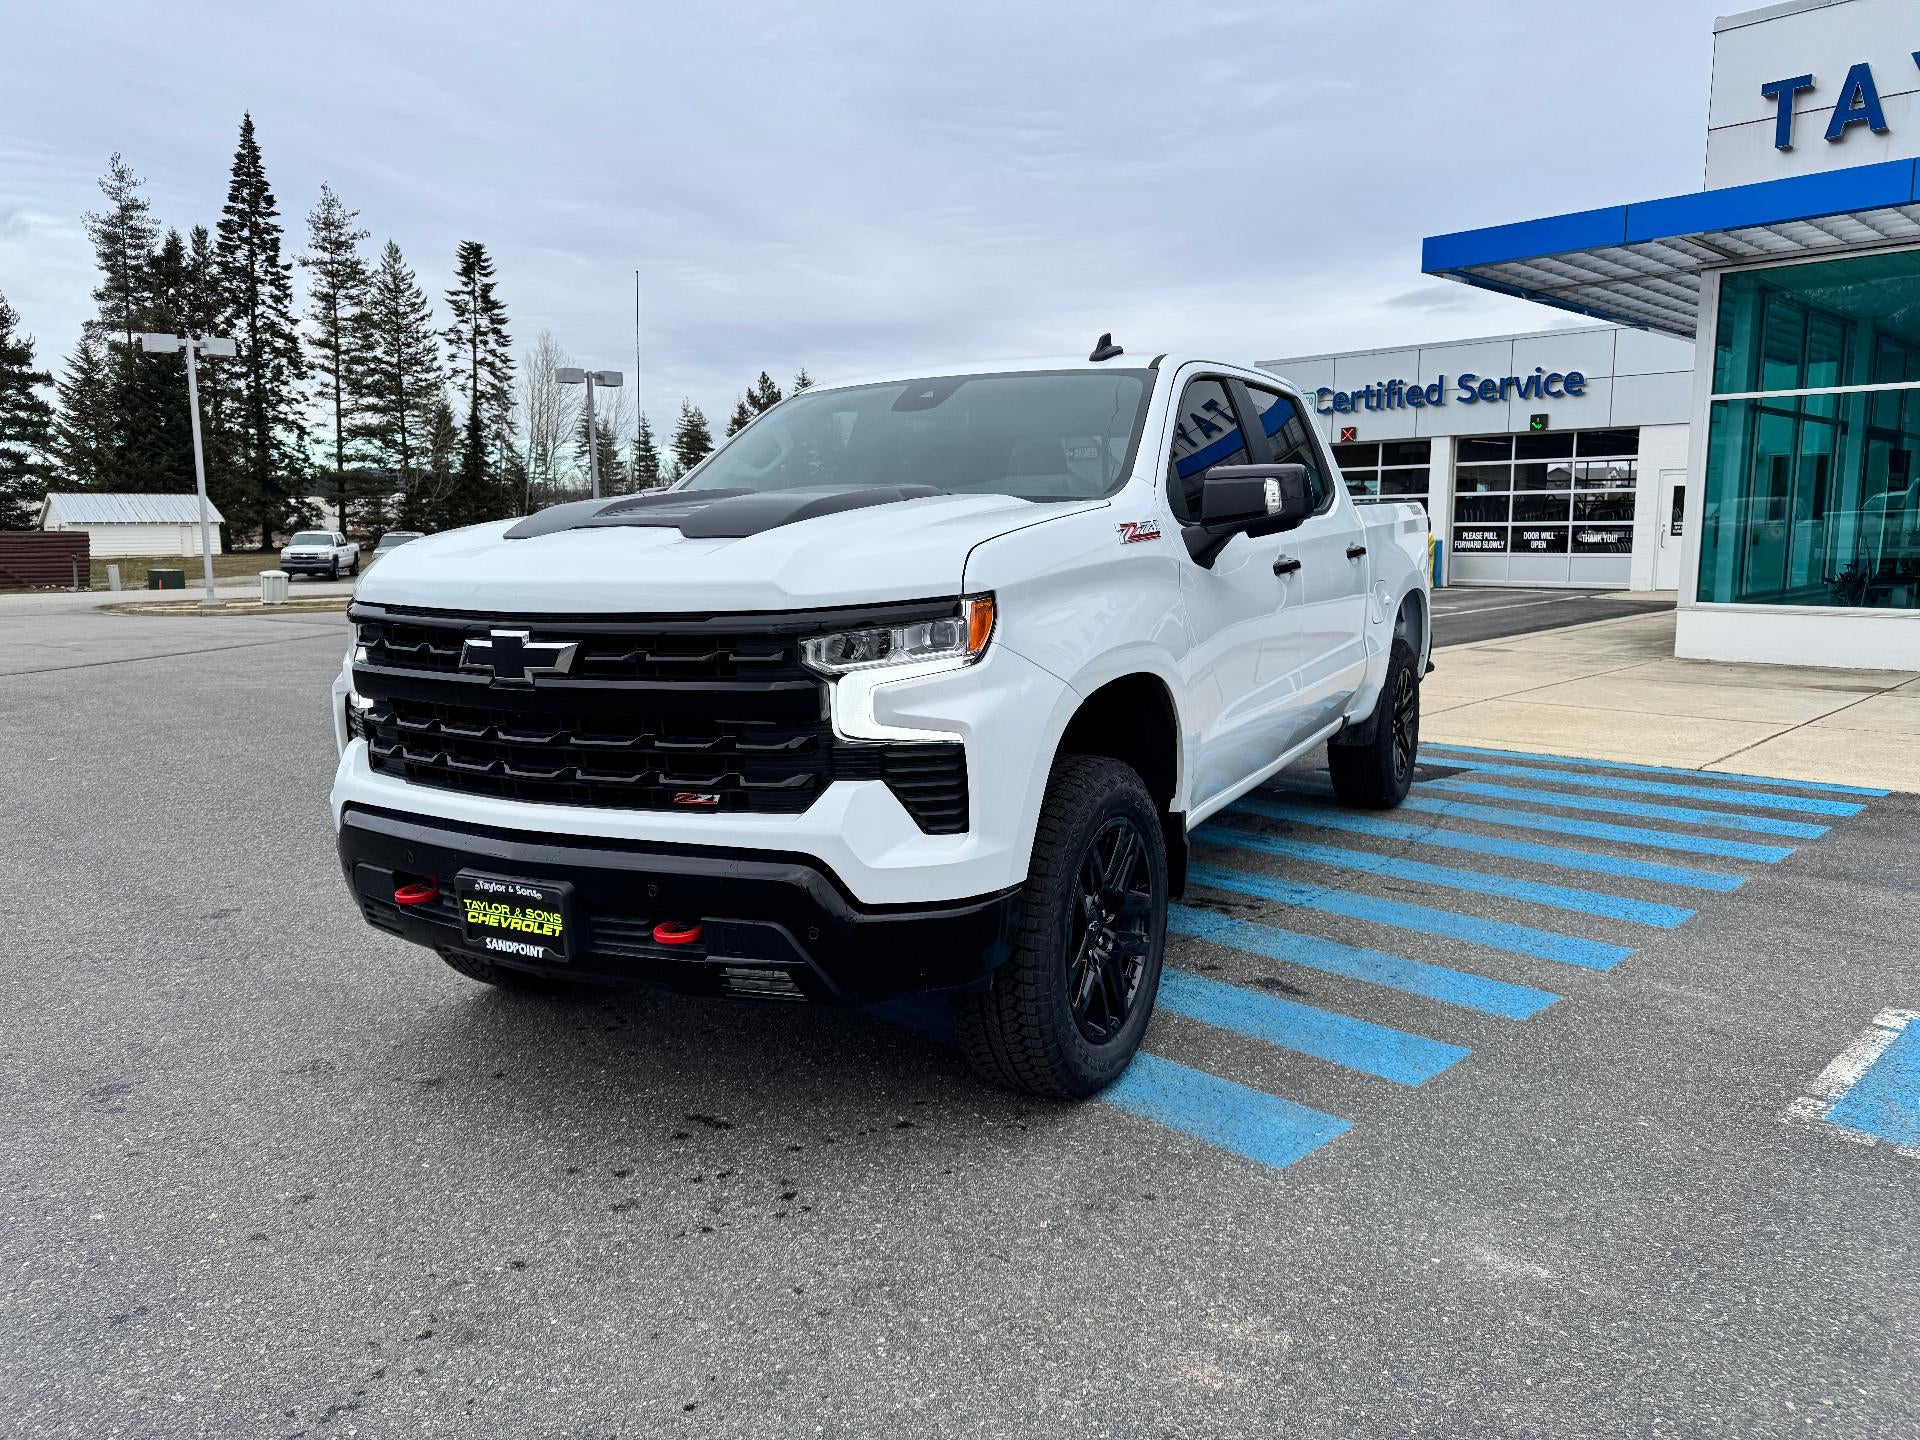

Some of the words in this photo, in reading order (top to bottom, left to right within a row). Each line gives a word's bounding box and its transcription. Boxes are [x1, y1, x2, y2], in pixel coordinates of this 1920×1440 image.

[1761, 51, 1920, 151] TA
[1316, 375, 1446, 415] Certified
[1456, 366, 1586, 404] Service
[1462, 531, 1483, 539] PLEASE
[1483, 531, 1498, 539] PULL
[1523, 531, 1539, 540] DOOR
[1540, 531, 1555, 539] WILL
[1581, 534, 1603, 543] THANK
[1603, 533, 1618, 543] YOU!
[1454, 540, 1482, 549] FORWARD
[1482, 540, 1505, 549] SLOWLY
[1530, 540, 1547, 549] OPEN
[478, 880, 506, 894] Taylor
[516, 885, 537, 897] Sons
[463, 899, 510, 917] TAYLOR
[514, 908, 523, 918] &
[525, 908, 562, 924] SONS
[467, 911, 563, 937] CHEVROLET
[485, 938, 545, 959] SANDPOINT
